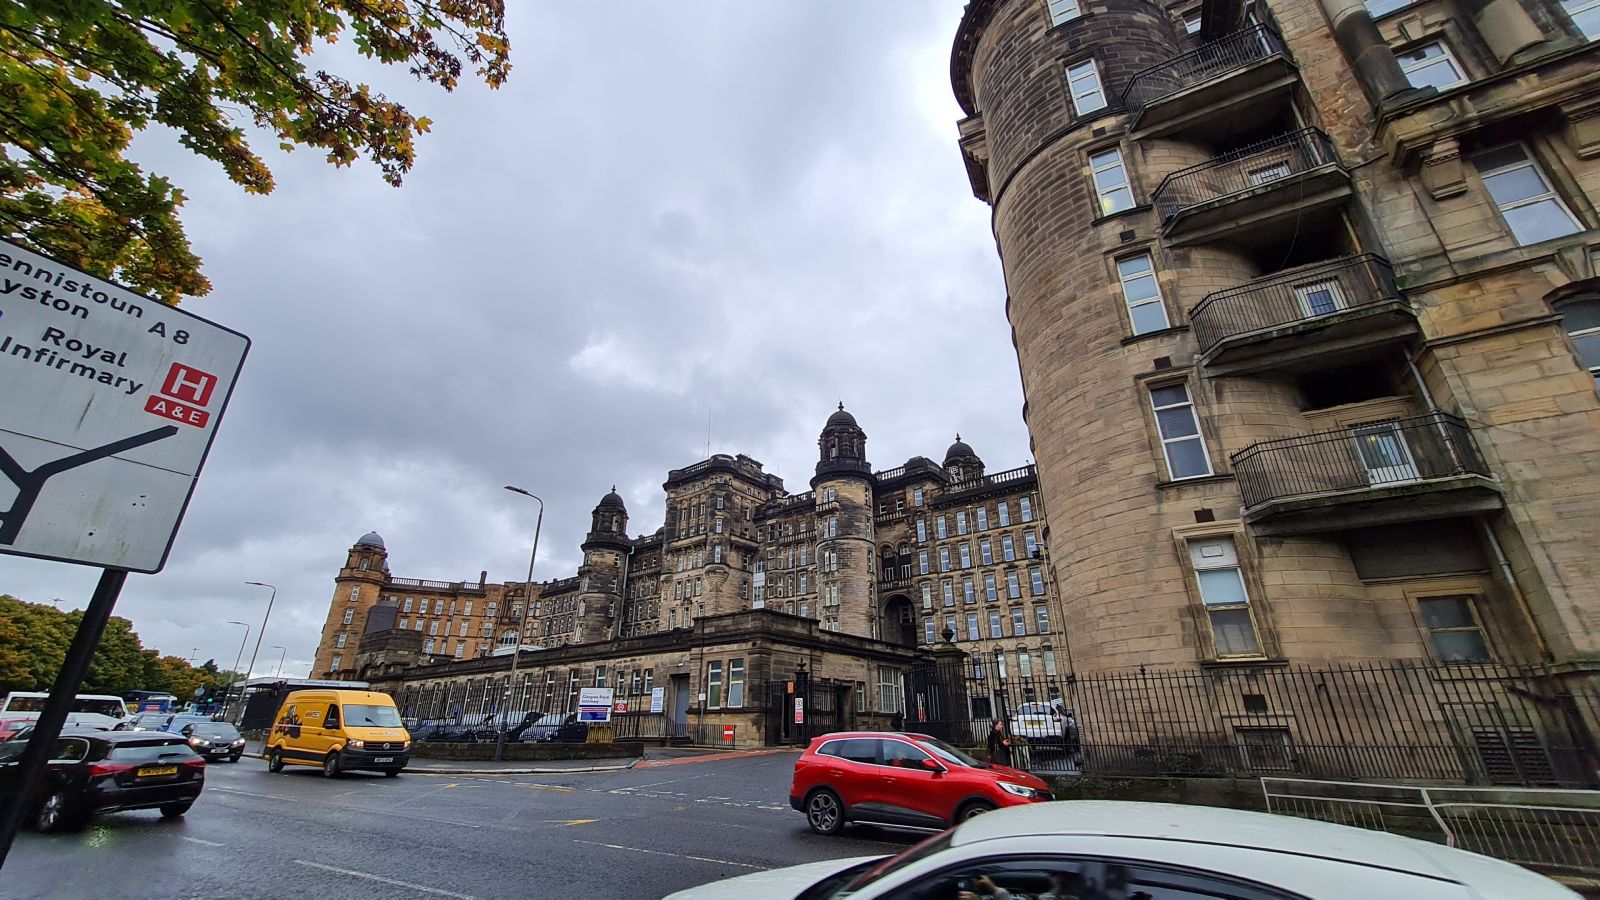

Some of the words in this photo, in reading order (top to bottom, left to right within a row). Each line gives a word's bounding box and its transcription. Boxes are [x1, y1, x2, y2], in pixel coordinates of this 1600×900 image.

[0, 253, 143, 318] ennistoun
[0, 336, 143, 395] Infirmary
[41, 326, 127, 367] Royal
[170, 368, 208, 401] H
